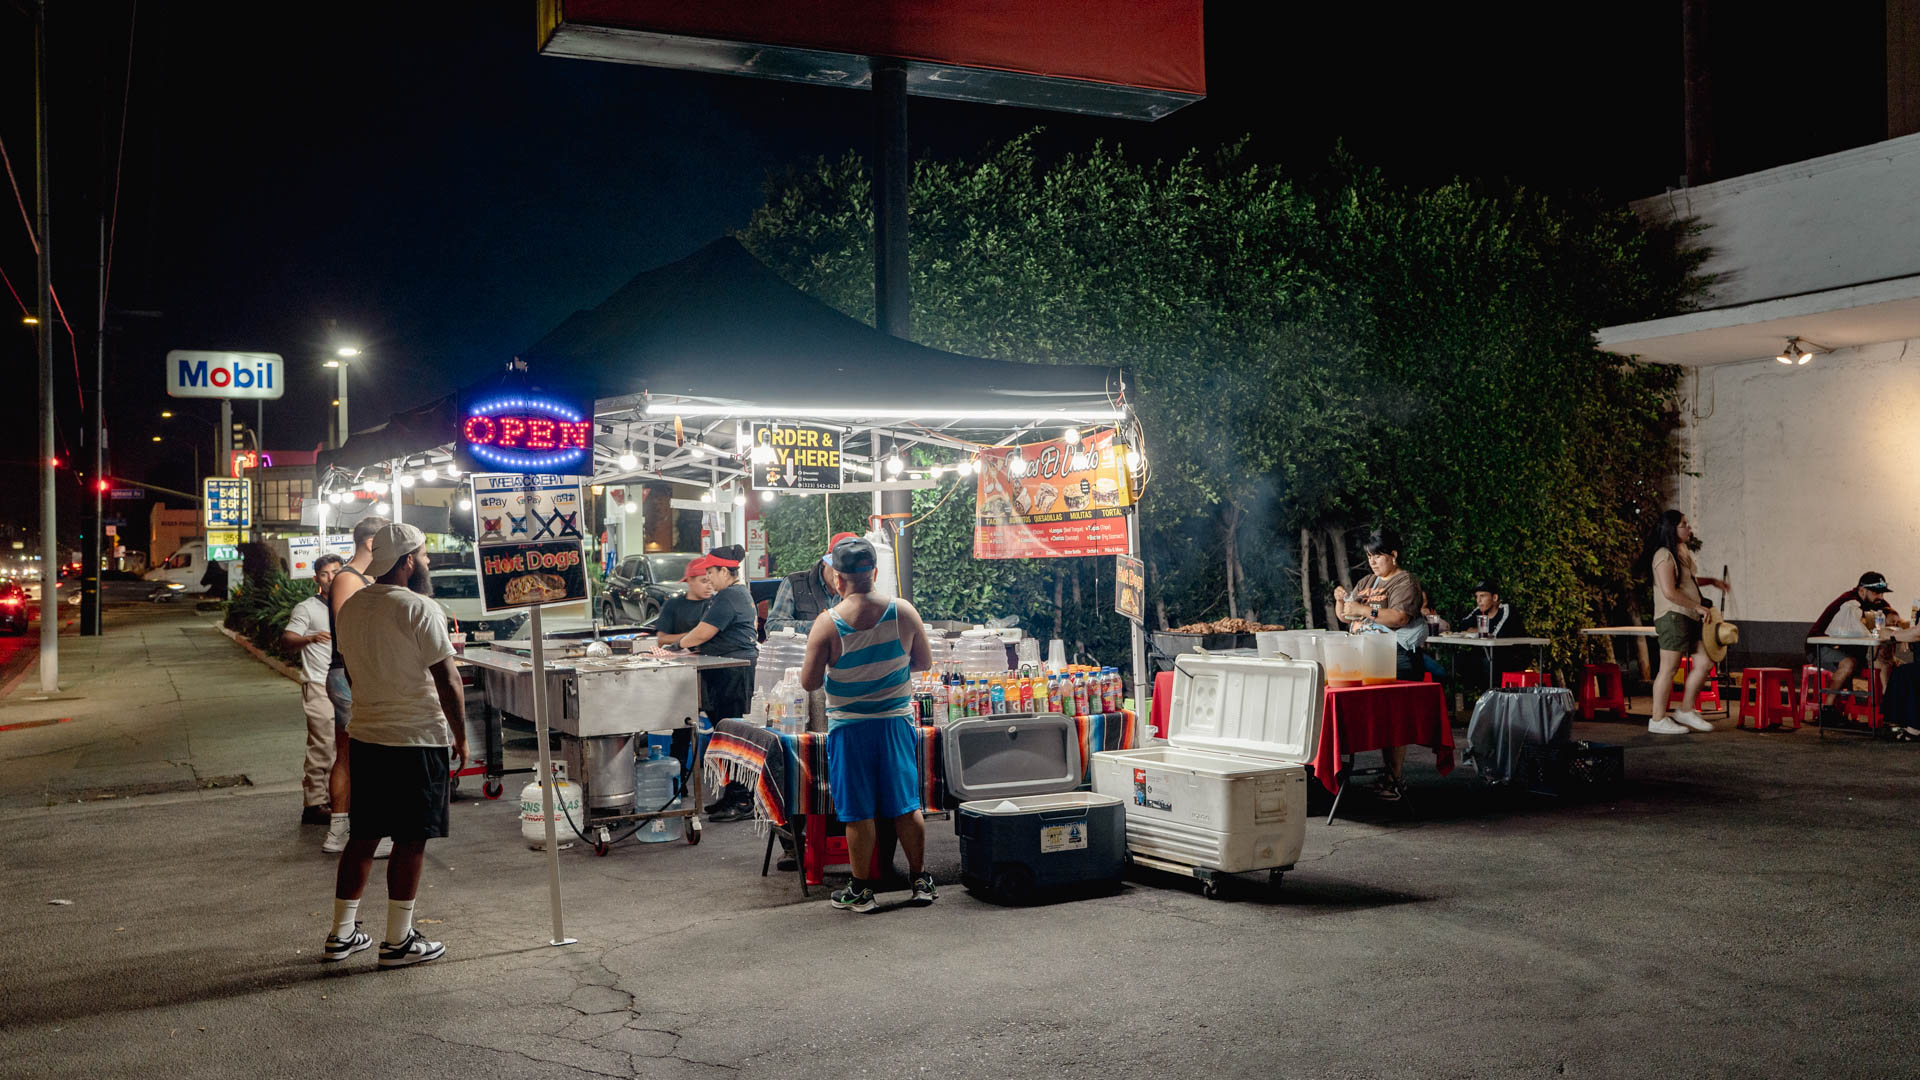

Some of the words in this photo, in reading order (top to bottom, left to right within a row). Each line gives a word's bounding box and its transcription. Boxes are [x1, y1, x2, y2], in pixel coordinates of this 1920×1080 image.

[178, 360, 273, 388] Mobil
[464, 416, 590, 449] OPEN
[757, 427, 819, 447] ORDER
[821, 432, 833, 447] &
[794, 448, 840, 468] HERE
[1005, 450, 1041, 482] Tcos
[1041, 446, 1061, 479] El
[489, 497, 507, 508] Pay
[1033, 512, 1063, 523] QUESADILLAS
[1070, 510, 1093, 520] MULITAS
[313, 536, 345, 544] ACEPT
[751, 528, 762, 540] 3x
[484, 554, 525, 575] Hot
[526, 550, 580, 572] Dogs
